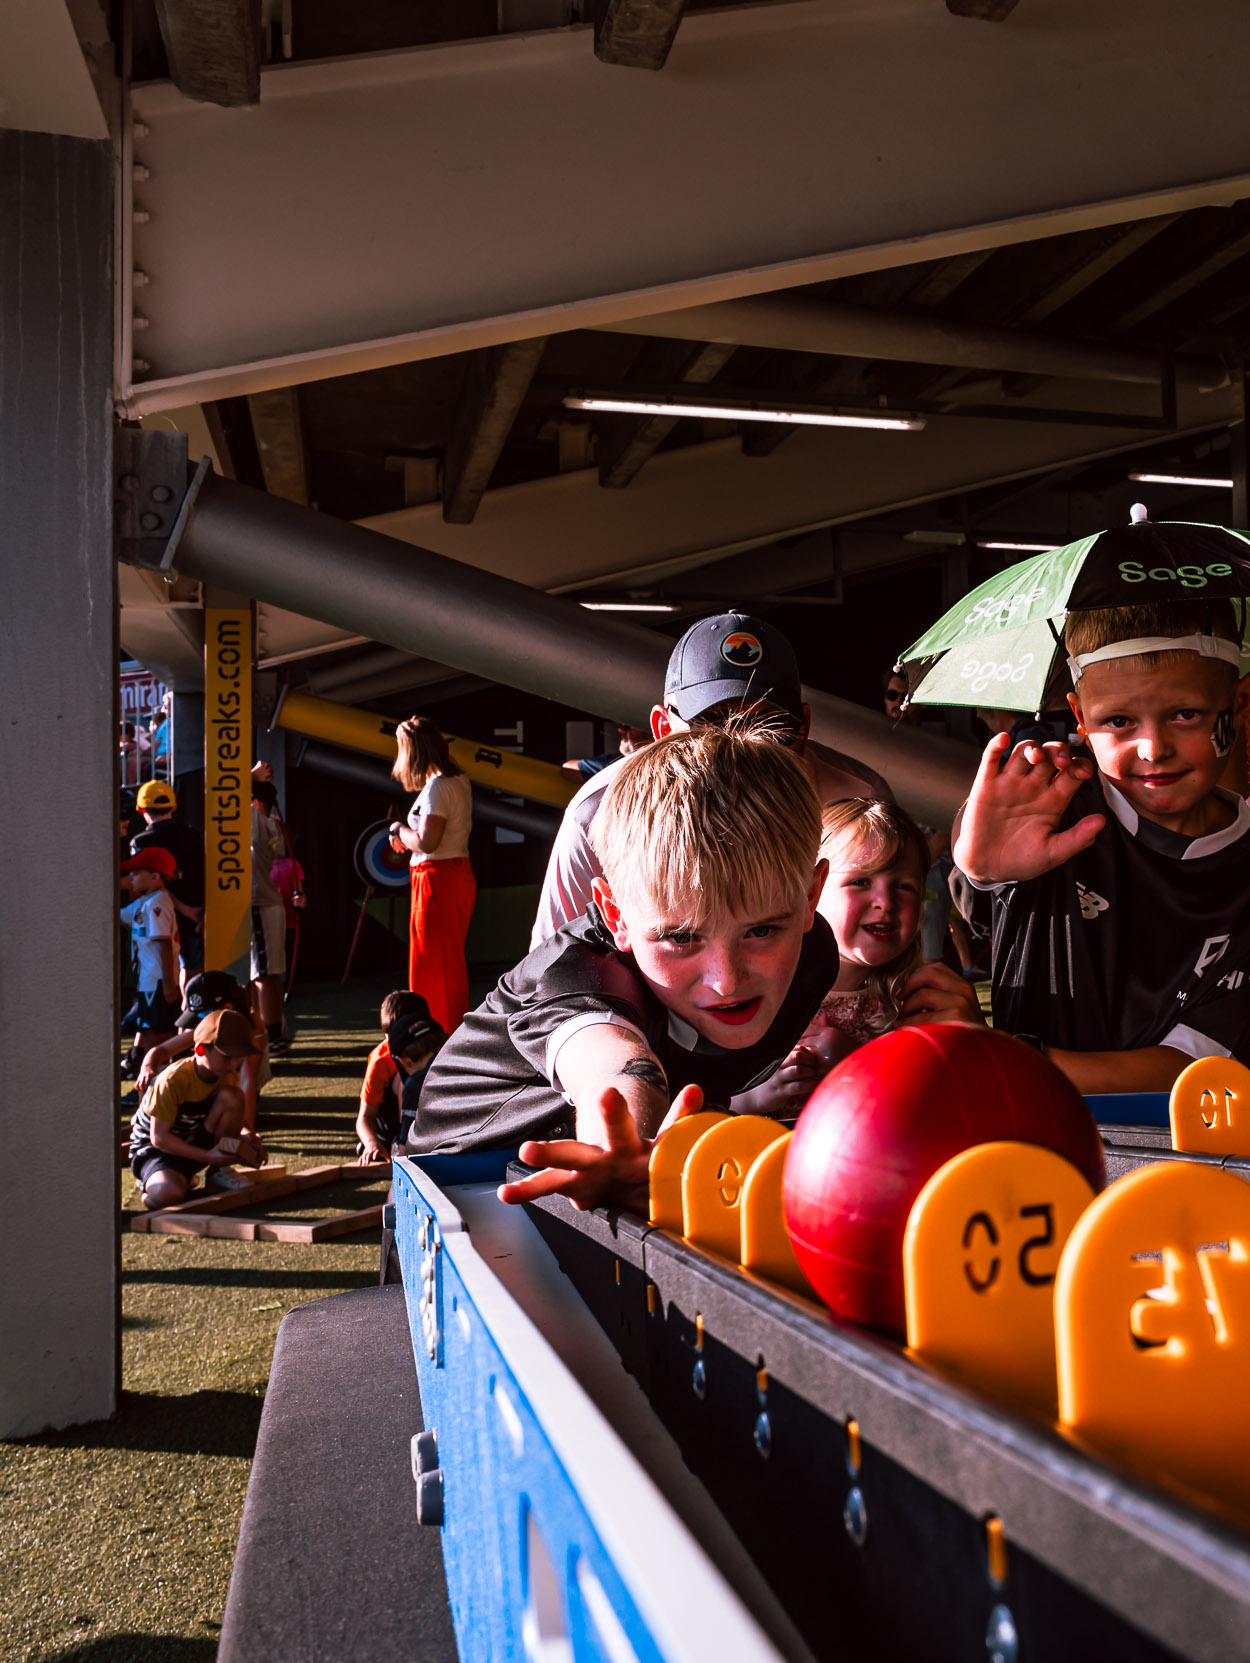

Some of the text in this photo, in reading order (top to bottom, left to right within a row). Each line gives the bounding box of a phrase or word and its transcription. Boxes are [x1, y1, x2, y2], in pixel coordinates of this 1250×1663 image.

[1118, 561, 1232, 588] Sage
[964, 587, 1046, 623] Sage
[212, 620, 244, 890] sportsbreaks.com
